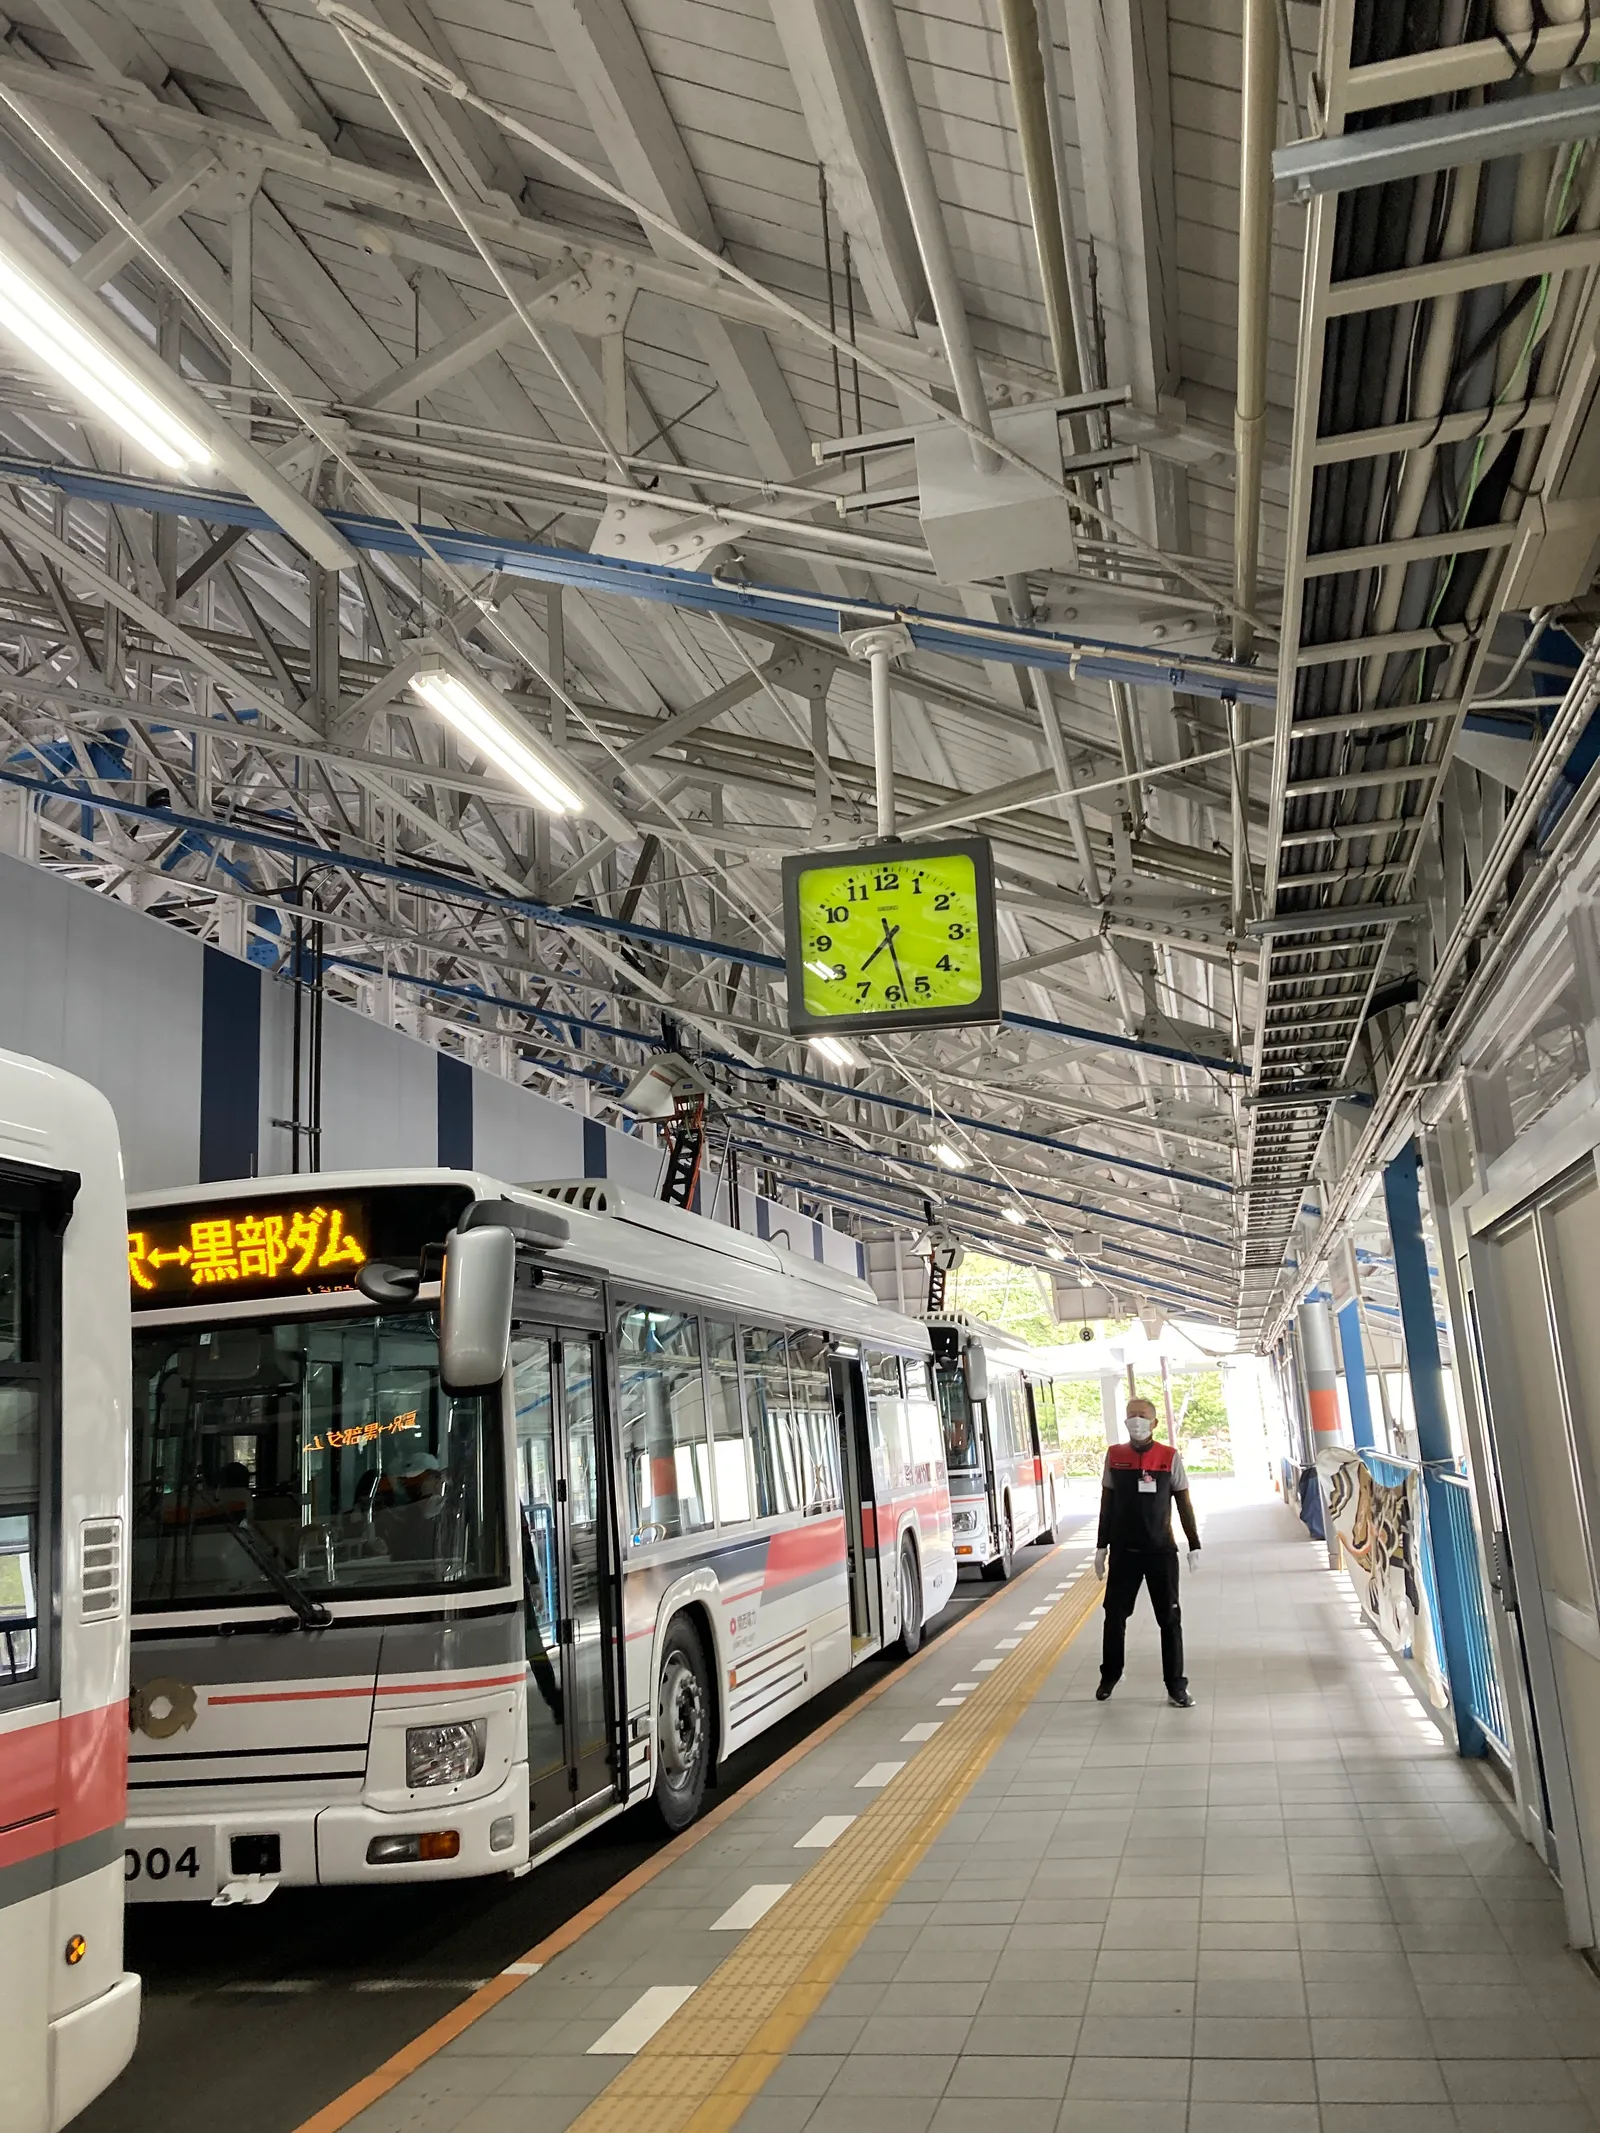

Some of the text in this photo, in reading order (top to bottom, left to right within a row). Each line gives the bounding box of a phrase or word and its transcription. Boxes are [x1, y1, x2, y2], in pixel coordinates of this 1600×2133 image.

[874, 873, 899, 892] 12
[912, 878, 922, 894] 1
[848, 885, 869, 902] 11
[934, 894, 950, 911] 2
[826, 906, 849, 924] 10
[948, 923, 964, 940] 3
[816, 935, 832, 952] 9
[936, 955, 952, 972] 4
[832, 964, 847, 981] 8
[856, 981, 872, 999] 7
[914, 976, 930, 993] 5
[885, 985, 900, 1002] 6
[941, 1248, 956, 1269] 7
[1083, 1330, 1091, 1341] 8
